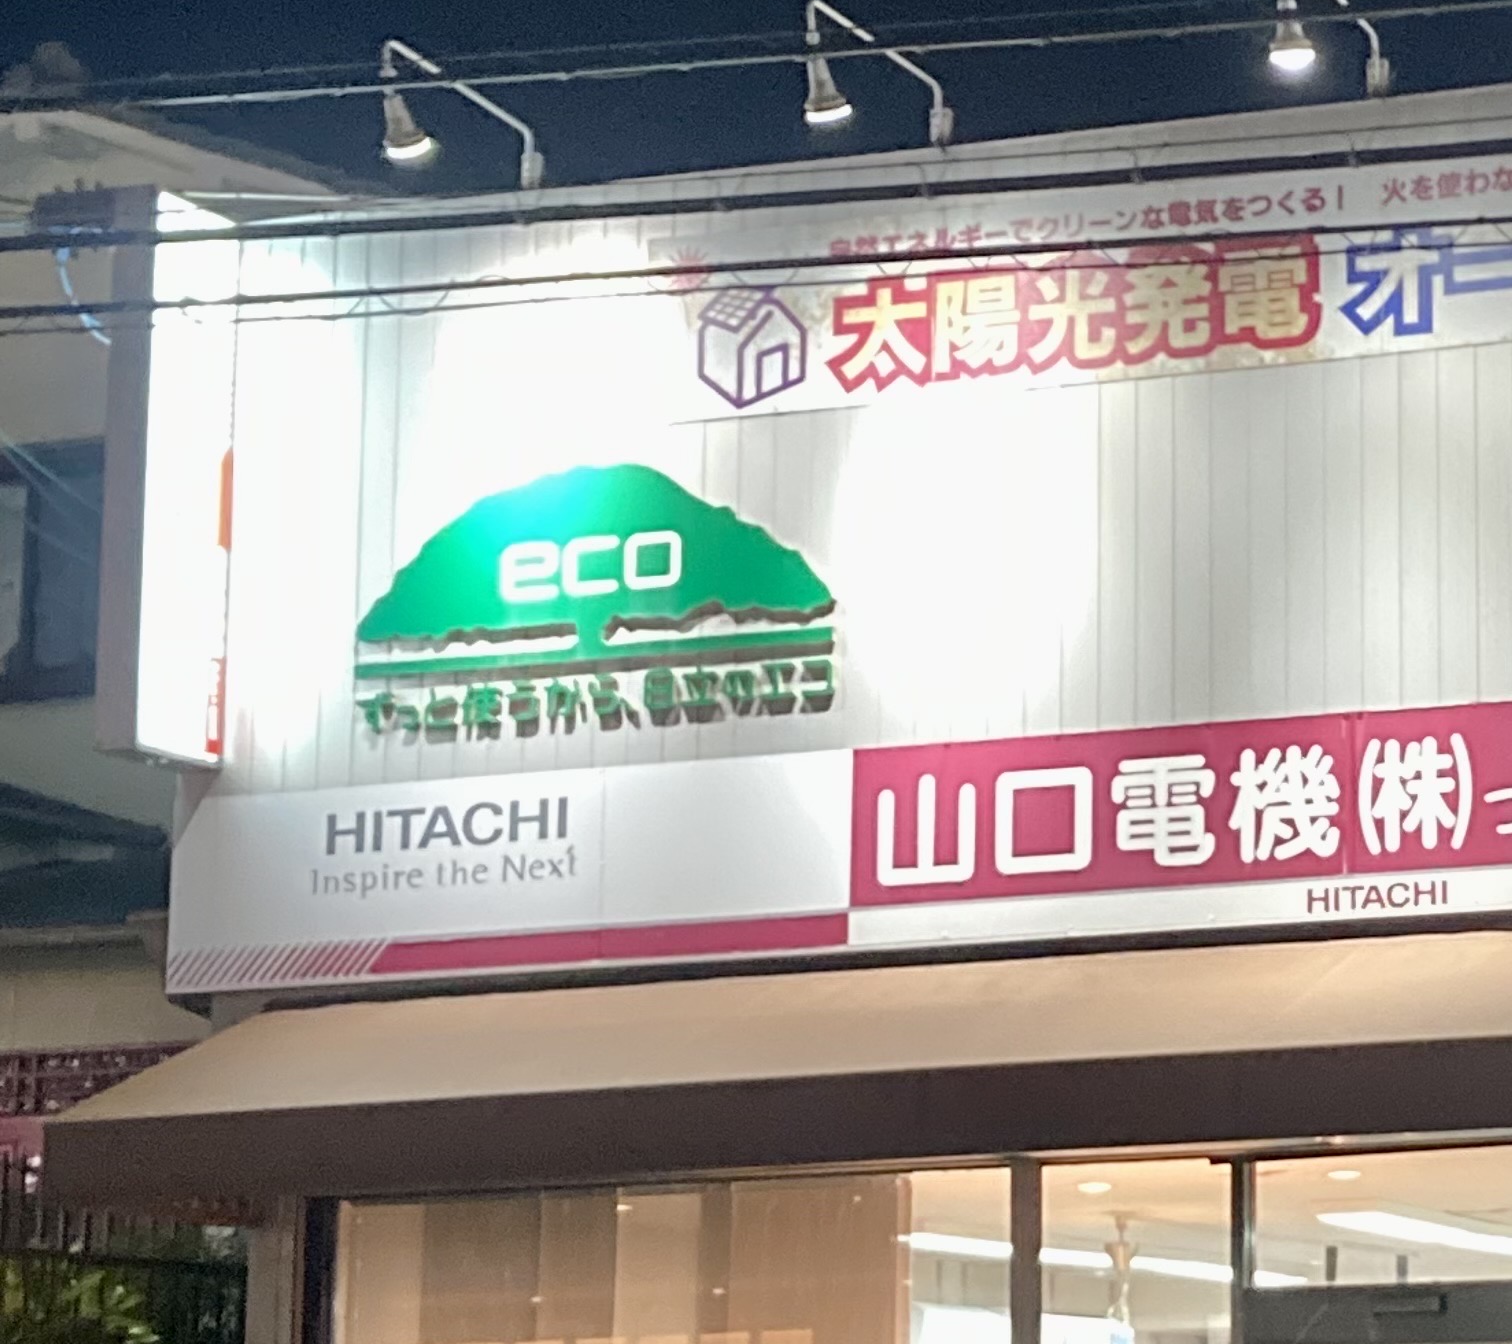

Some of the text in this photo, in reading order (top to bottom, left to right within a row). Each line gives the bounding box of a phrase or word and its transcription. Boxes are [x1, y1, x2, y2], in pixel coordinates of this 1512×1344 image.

[826, 230, 1322, 393] 太陽光発電
[497, 529, 684, 603] eco
[325, 796, 569, 856] HITACHI
[310, 844, 579, 900] Inspire the Next
[1305, 879, 1450, 916] HITACHI
